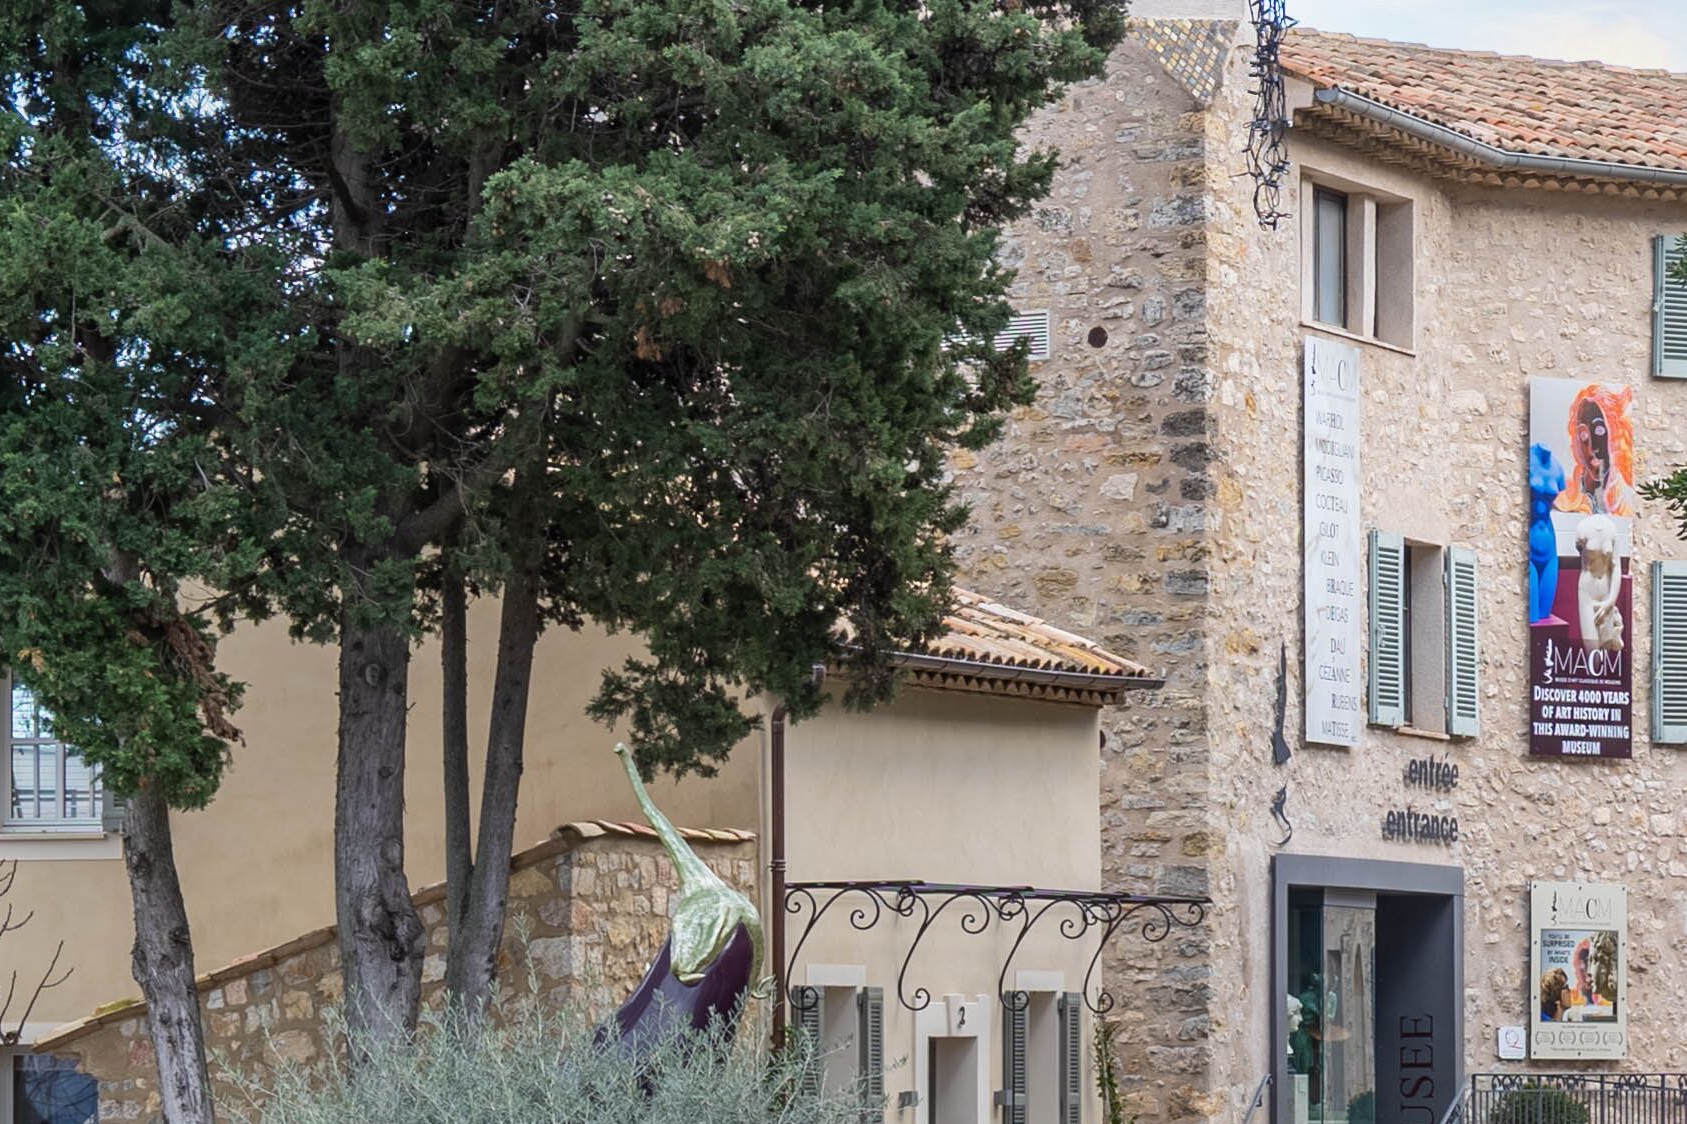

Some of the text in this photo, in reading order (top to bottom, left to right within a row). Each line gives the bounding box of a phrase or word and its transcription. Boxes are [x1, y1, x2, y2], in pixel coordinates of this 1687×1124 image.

[1316, 464, 1344, 485] PICASSO
[1316, 493, 1348, 514] COCTEAU
[1326, 605, 1349, 623] DEGAS
[1554, 646, 1622, 677] MACM
[1578, 690, 1601, 704] 4000
[1603, 691, 1630, 705] YEARS
[1542, 705, 1621, 721] OF ART HISTORY IN
[1322, 720, 1349, 738] MATISSE
[1533, 722, 1630, 739] THIS AWARD-WINNING
[1561, 740, 1601, 755] MUSEUM
[1408, 752, 1459, 789] entrée
[1385, 805, 1459, 842] entrance
[957, 1006, 966, 1030] 2
